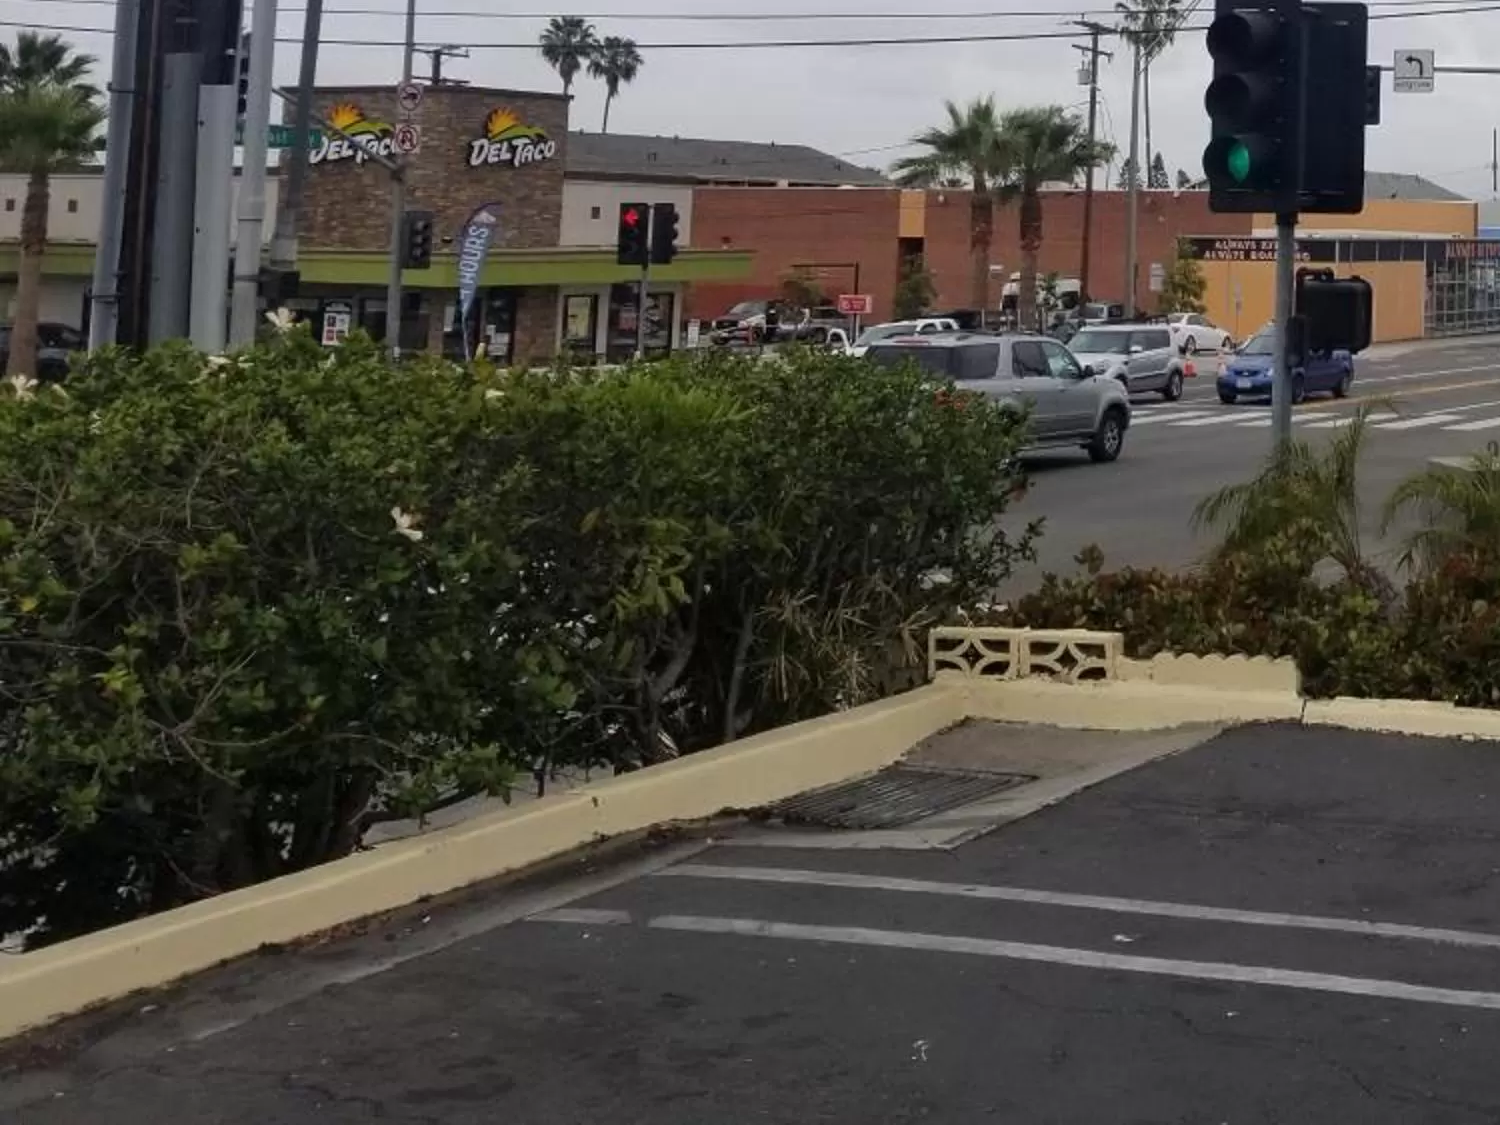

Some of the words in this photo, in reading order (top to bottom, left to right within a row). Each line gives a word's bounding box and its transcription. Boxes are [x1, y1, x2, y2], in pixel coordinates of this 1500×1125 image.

[309, 137, 353, 164] DEL
[469, 138, 512, 166] DEL
[512, 137, 556, 167] TACO
[459, 225, 489, 285] HOURS
